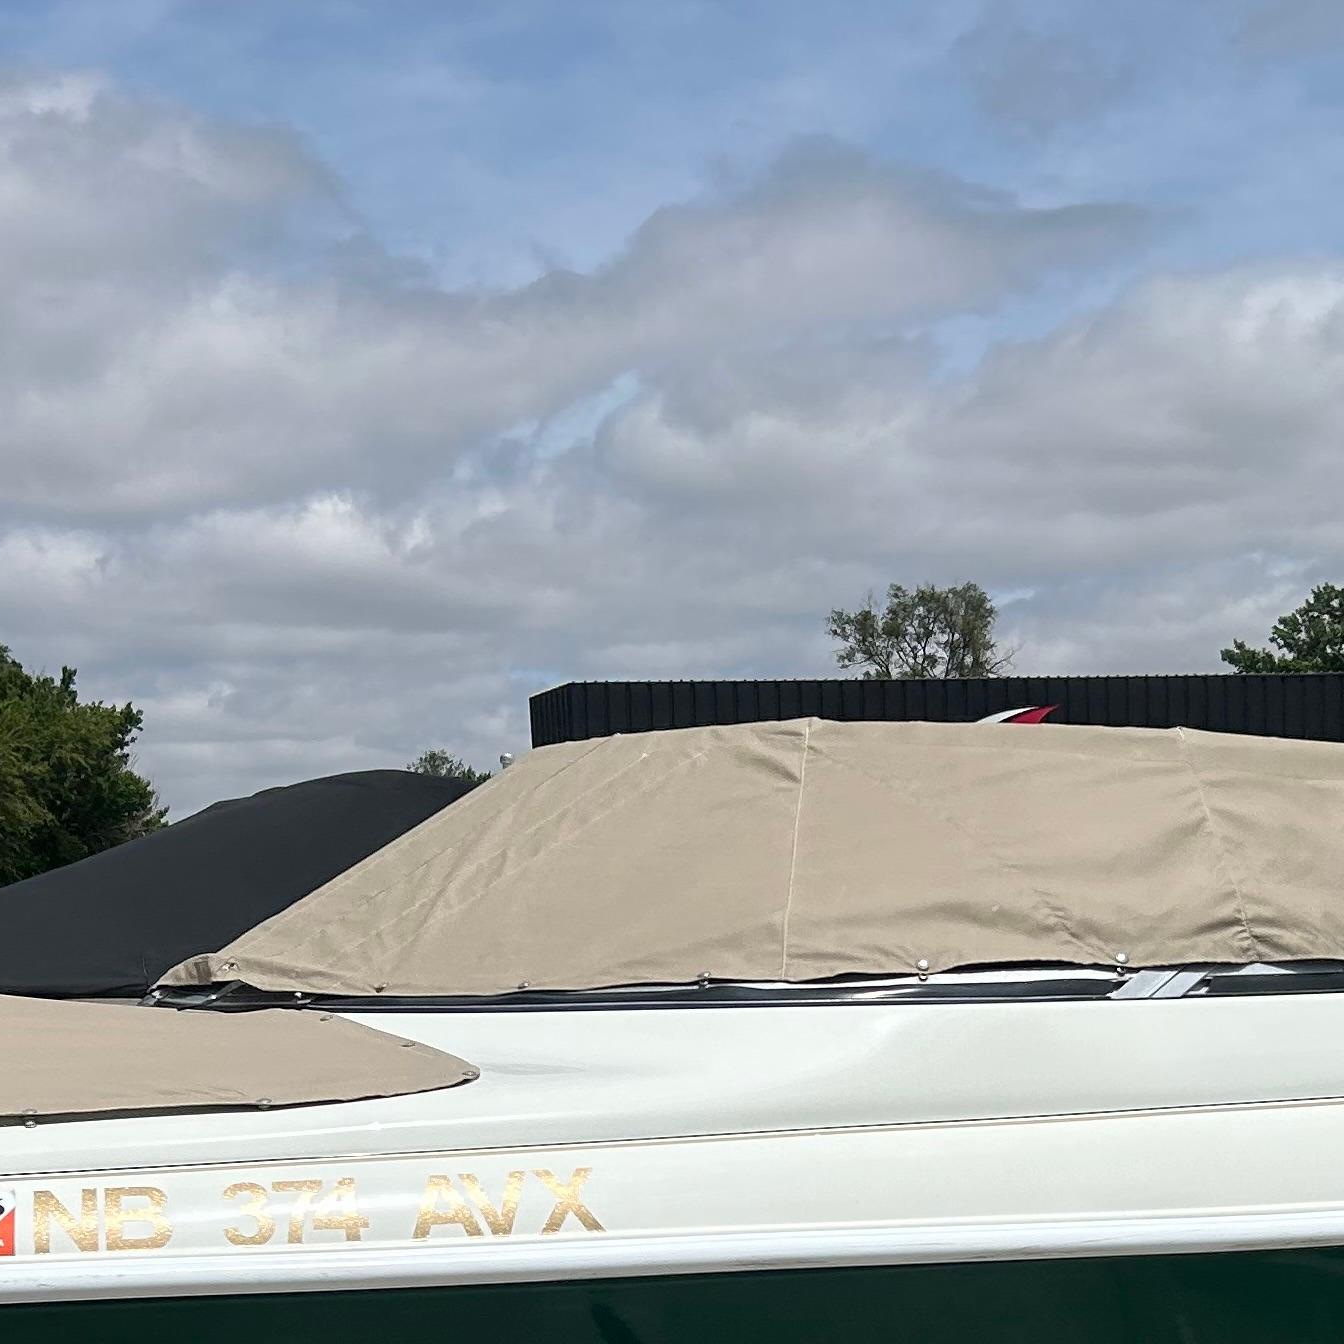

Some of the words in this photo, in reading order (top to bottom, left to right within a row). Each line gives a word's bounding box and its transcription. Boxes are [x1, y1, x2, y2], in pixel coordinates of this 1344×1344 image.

[32, 1186, 174, 1255] NB
[222, 1177, 370, 1247] 374
[411, 1167, 609, 1243] AVX
